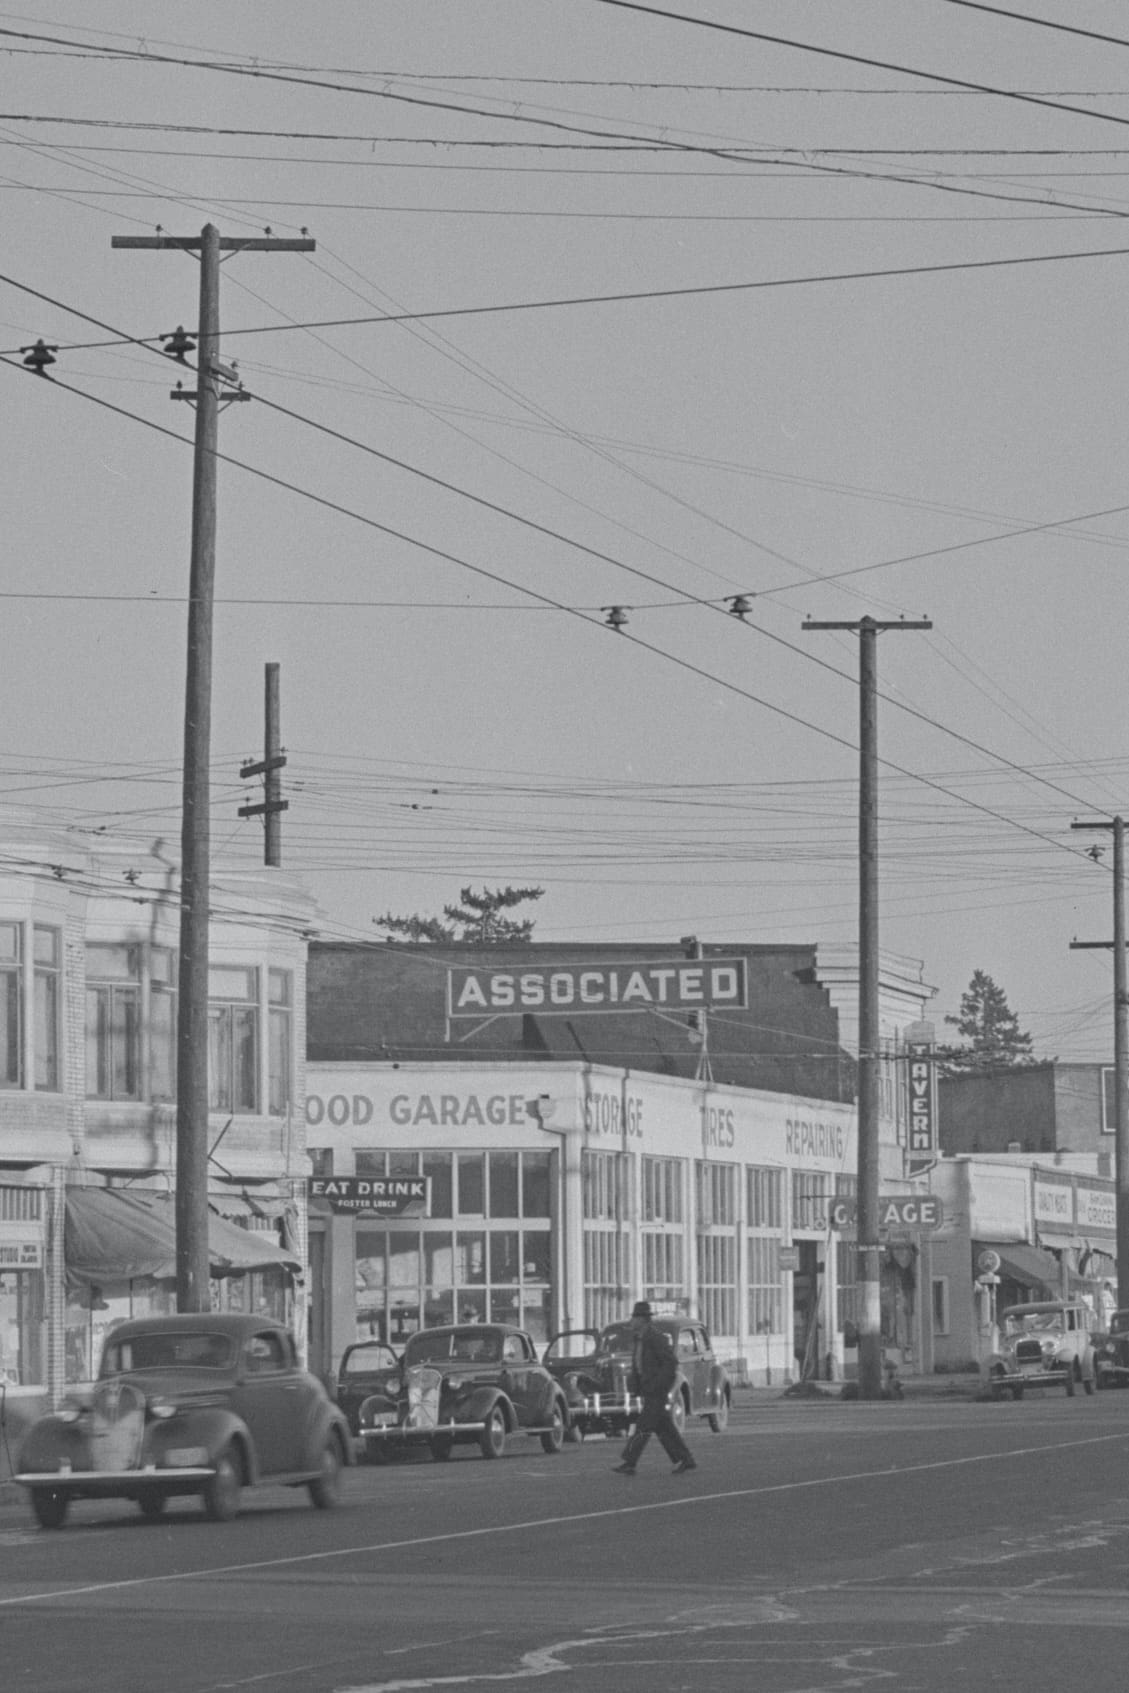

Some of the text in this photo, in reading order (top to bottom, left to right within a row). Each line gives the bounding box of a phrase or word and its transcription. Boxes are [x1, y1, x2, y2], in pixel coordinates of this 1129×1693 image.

[458, 967, 738, 1008] ASSOCIATED
[389, 1094, 525, 1126] GARAGE
[912, 1045, 929, 1149] TAVERN
[786, 1118, 844, 1159] REPAIRING
[312, 1181, 424, 1196] EAT DRINK
[338, 1199, 370, 1208] FOSTER
[834, 1203, 936, 1225] GAGE
